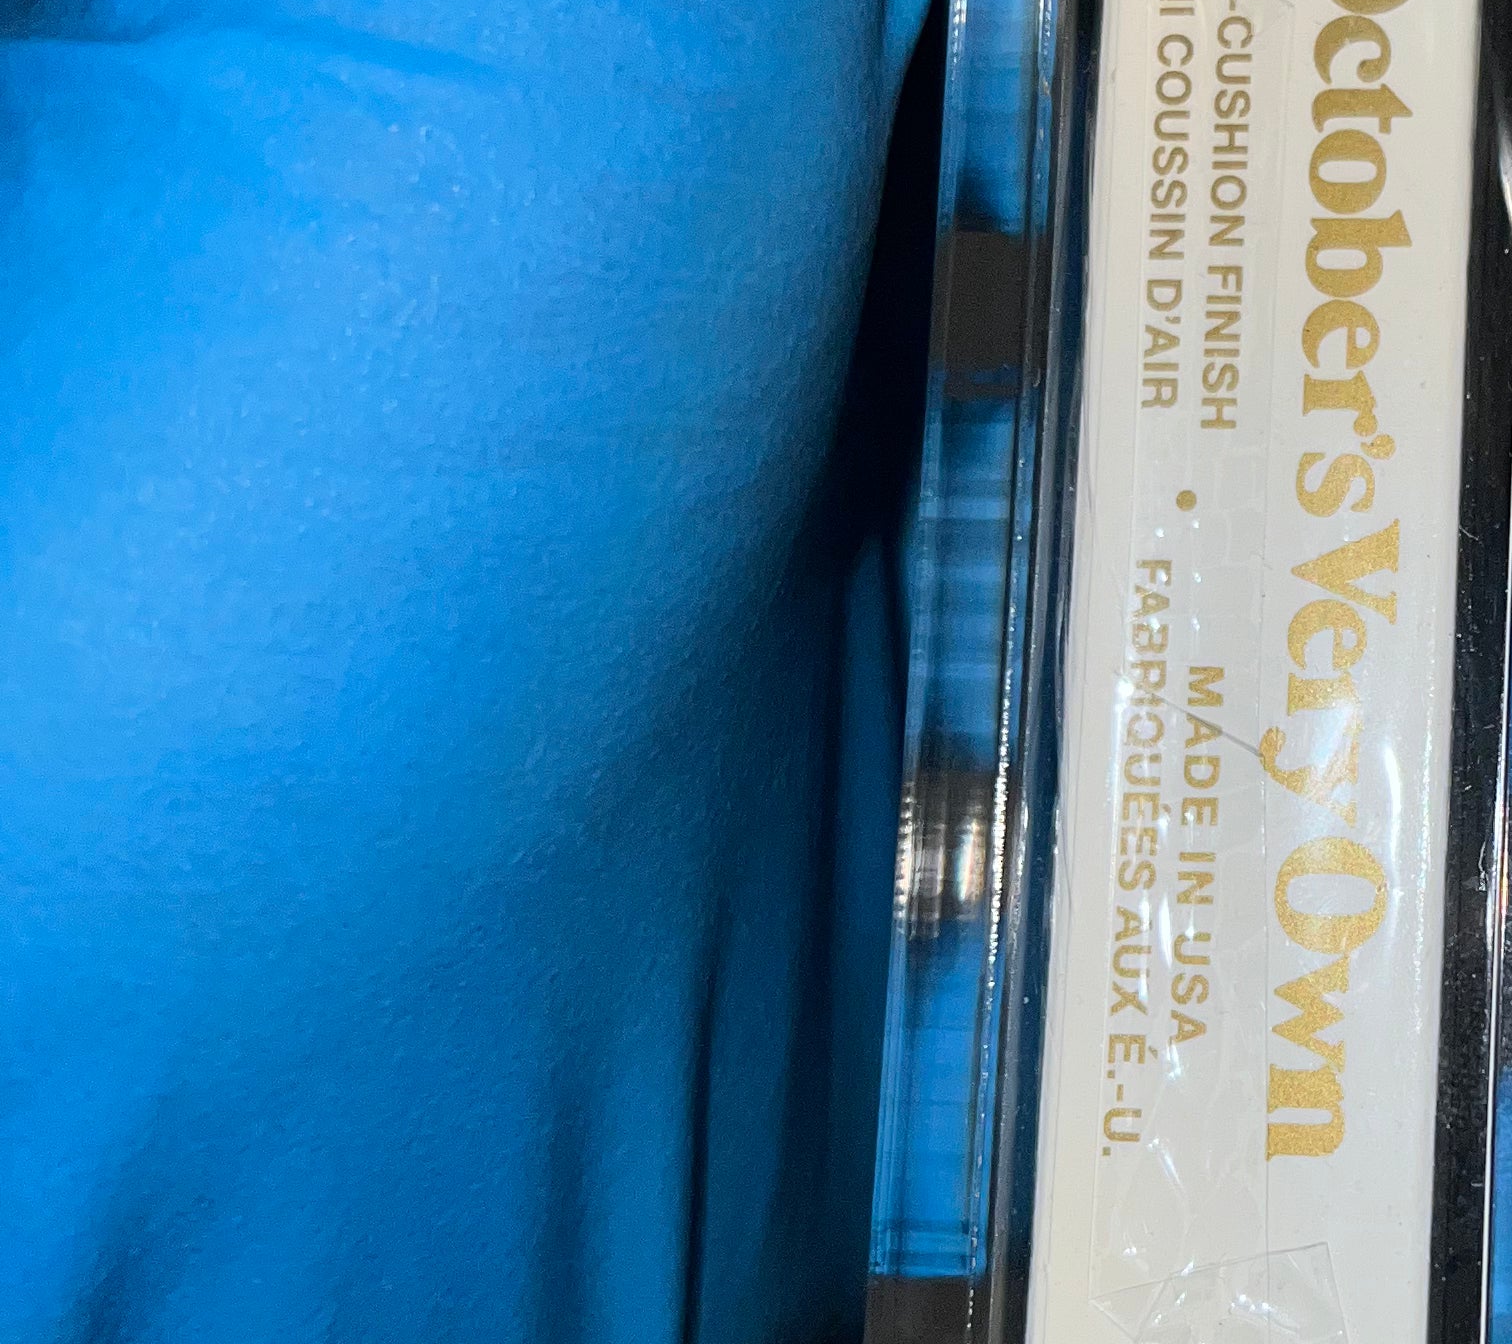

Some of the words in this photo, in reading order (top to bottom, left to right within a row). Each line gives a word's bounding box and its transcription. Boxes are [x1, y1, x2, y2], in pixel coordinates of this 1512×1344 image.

[1147, 33, 1195, 261] COUSSIN
[1141, 279, 1183, 410] D'AIR
[1200, 265, 1245, 430] FINISH
[1180, 665, 1226, 828] MADE
[1259, 518, 1400, 829] Very
[1176, 851, 1217, 906] IN
[1108, 905, 1153, 1018] AUX
[1168, 931, 1213, 1046] USA
[1265, 836, 1388, 1162] Own
